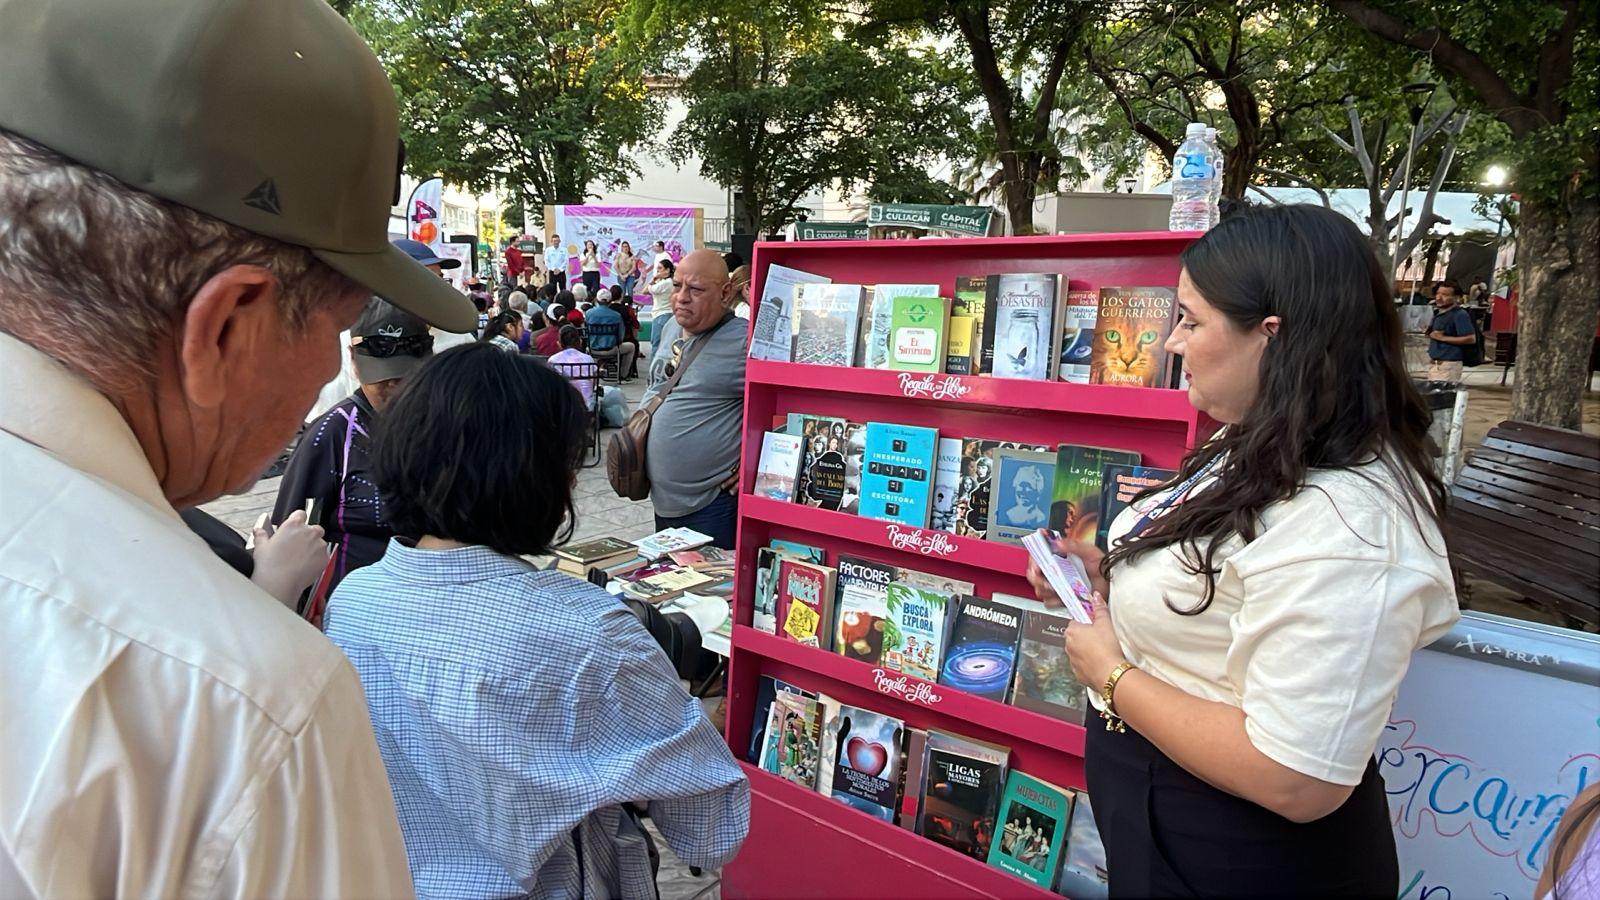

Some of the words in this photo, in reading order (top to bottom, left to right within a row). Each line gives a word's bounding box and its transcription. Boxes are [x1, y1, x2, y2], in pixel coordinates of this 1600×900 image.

[941, 213, 981, 227] CAPITAL
[597, 227, 613, 235] 494
[1000, 295, 1048, 308] DESASTRE
[1102, 296, 1124, 307] LOS
[1128, 297, 1172, 308] GATOS
[1101, 308, 1169, 319] GUERREROS
[1110, 373, 1144, 384] AURORA
[897, 372, 935, 397] Regala
[932, 376, 971, 400] Libro
[873, 452, 922, 465] INESPERADO
[1070, 466, 1080, 474] La
[871, 492, 915, 505] ESCRITORA
[886, 524, 923, 550] Regala
[920, 533, 959, 556] Libro
[839, 562, 890, 584] FACTORES
[838, 575, 889, 594] AMBIENTALES
[903, 602, 929, 618] BUSCA
[963, 604, 1018, 629] ANDRÓMEDA
[902, 614, 934, 632] EXPLORA
[872, 669, 908, 696] Regala
[905, 682, 943, 705] Libro
[949, 763, 981, 778] LIGAS
[948, 772, 980, 785] MAYORES
